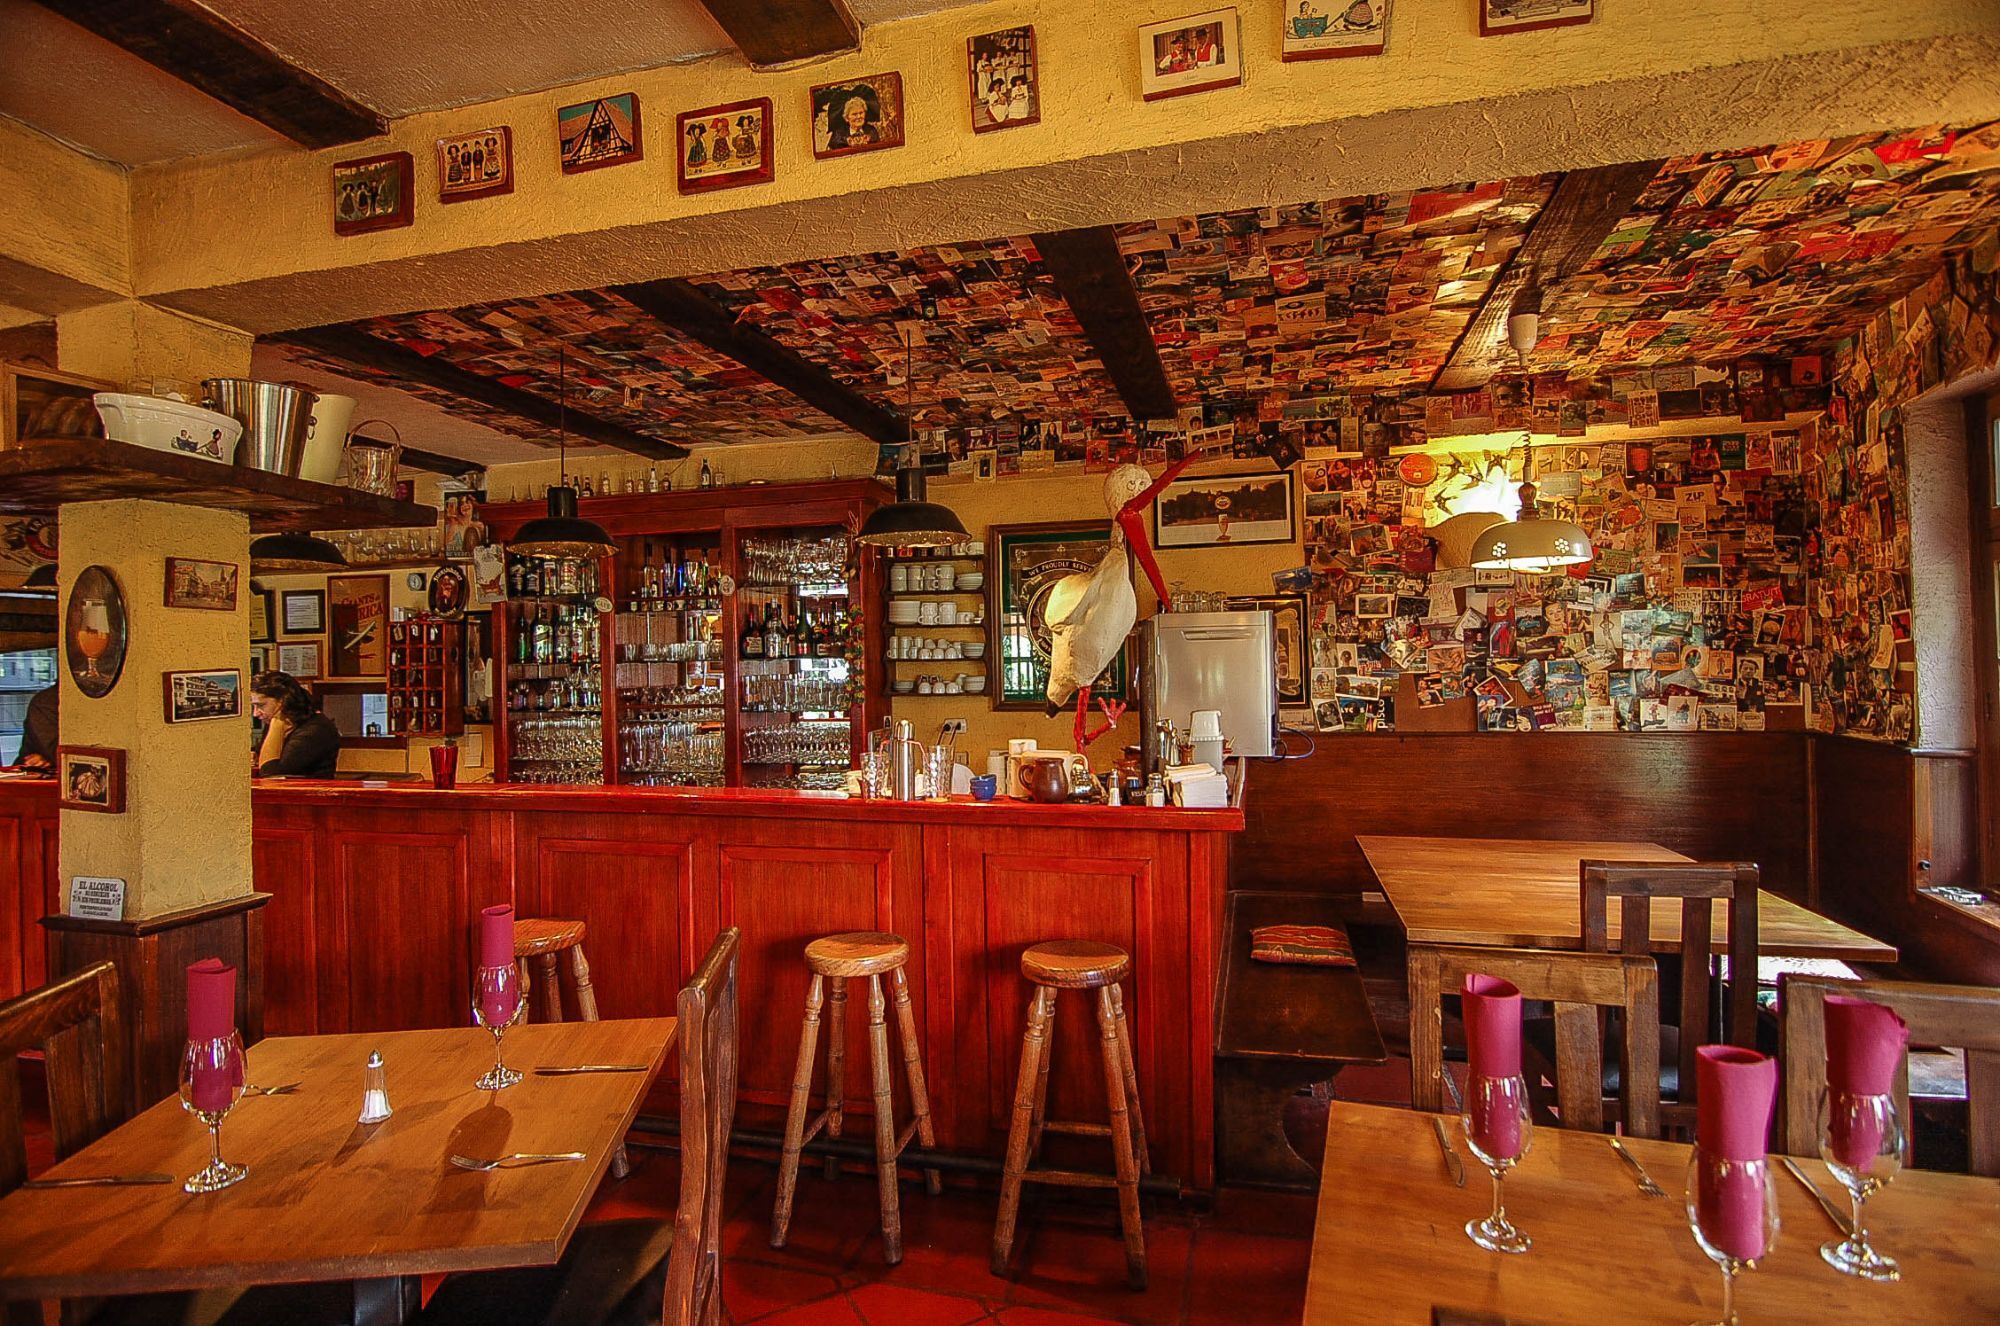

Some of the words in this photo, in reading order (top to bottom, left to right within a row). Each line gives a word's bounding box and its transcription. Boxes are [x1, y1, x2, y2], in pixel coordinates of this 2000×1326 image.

[1028, 567, 1039, 576] WE
[1041, 561, 1069, 571] PROUDLY
[1377, 699, 1389, 729] pisco
[78, 881, 88, 890] EL
[89, 882, 118, 892] ALCOHOL
